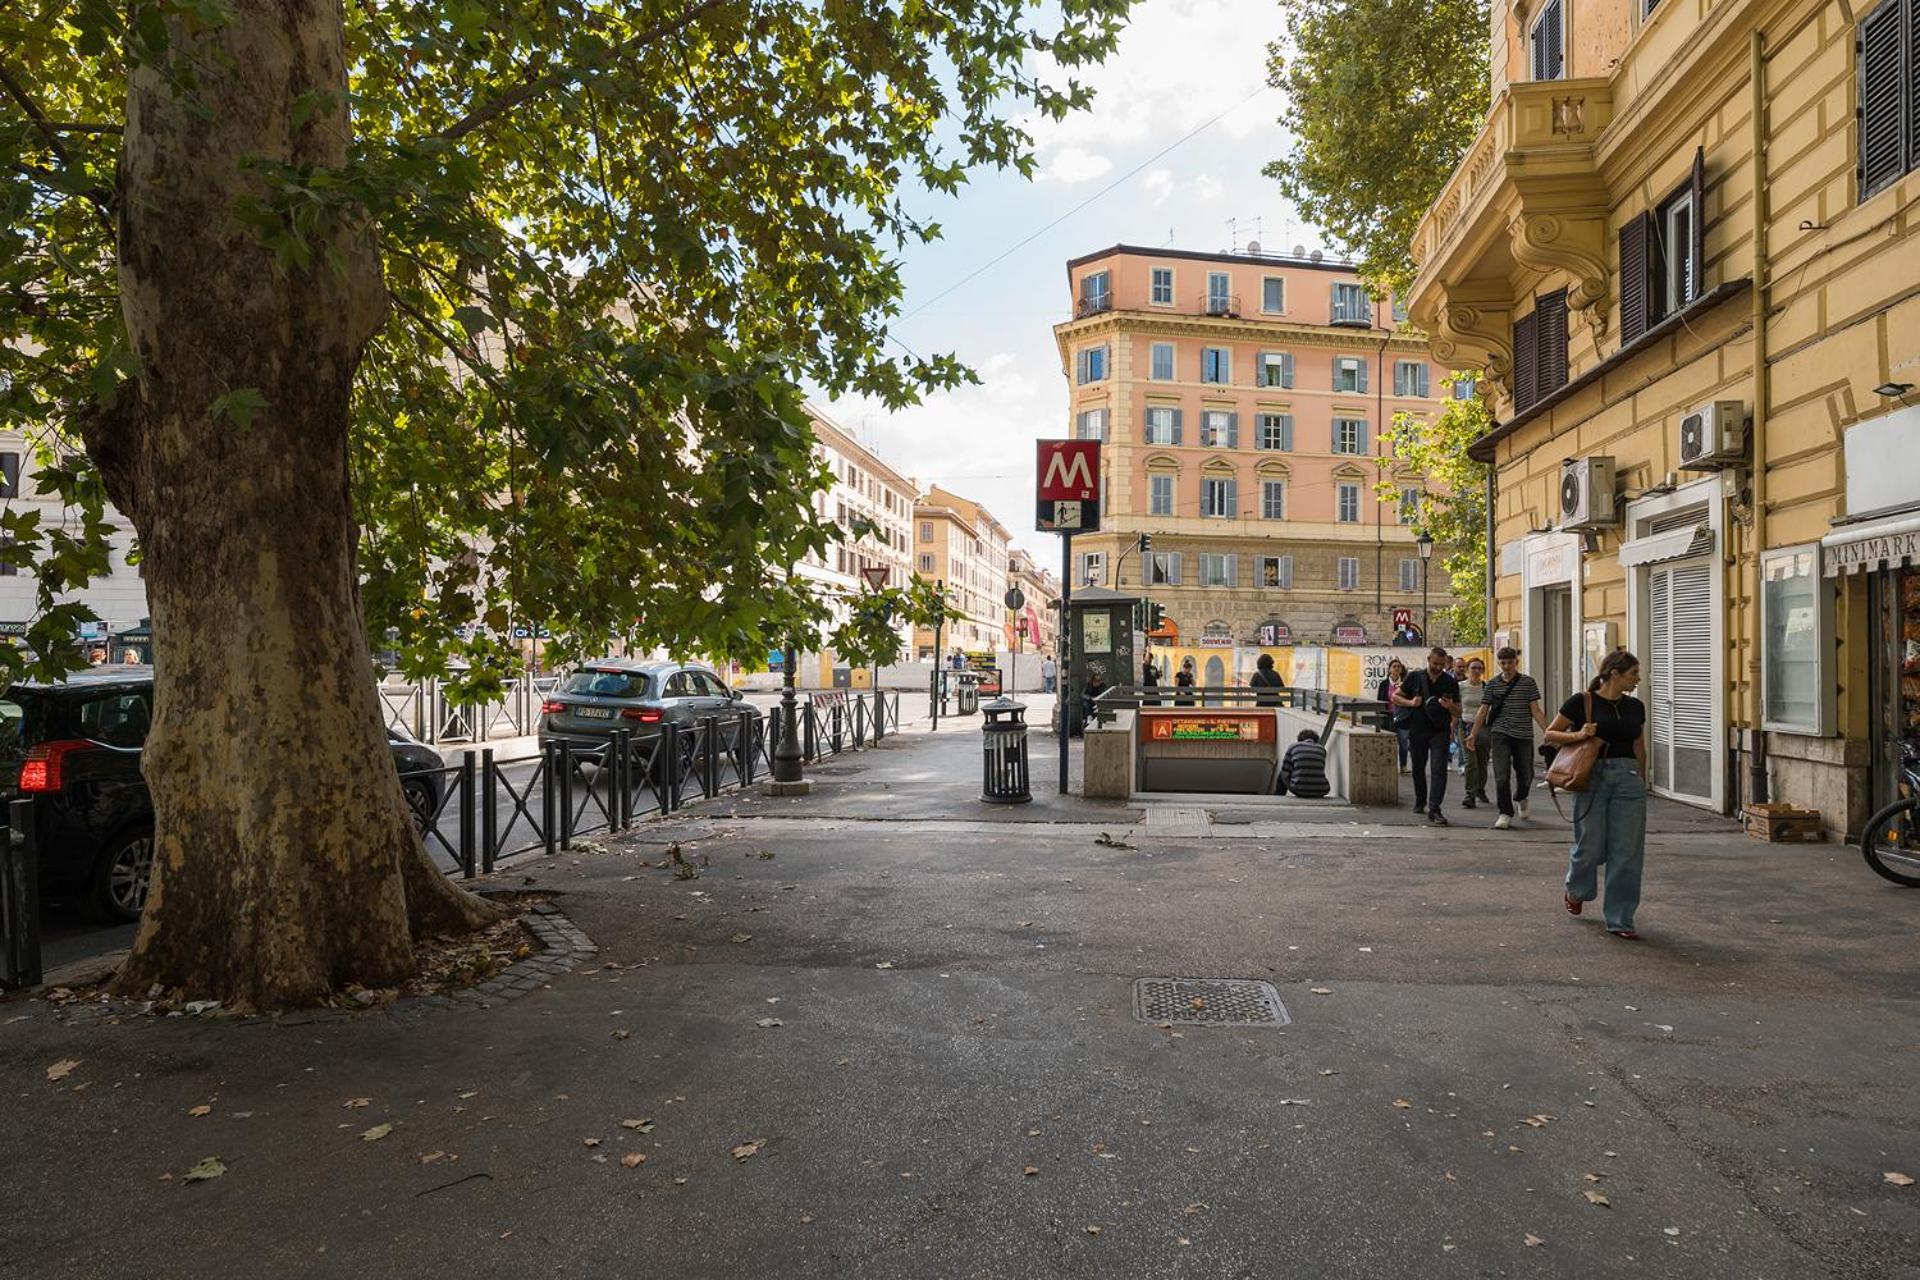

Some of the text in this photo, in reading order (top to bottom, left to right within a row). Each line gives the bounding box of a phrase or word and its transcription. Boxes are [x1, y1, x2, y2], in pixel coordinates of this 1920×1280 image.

[1042, 451, 1094, 488] M
[1832, 534, 1916, 565] MINIMARK
[1395, 612, 1409, 622] M
[1158, 725, 1168, 736] A
